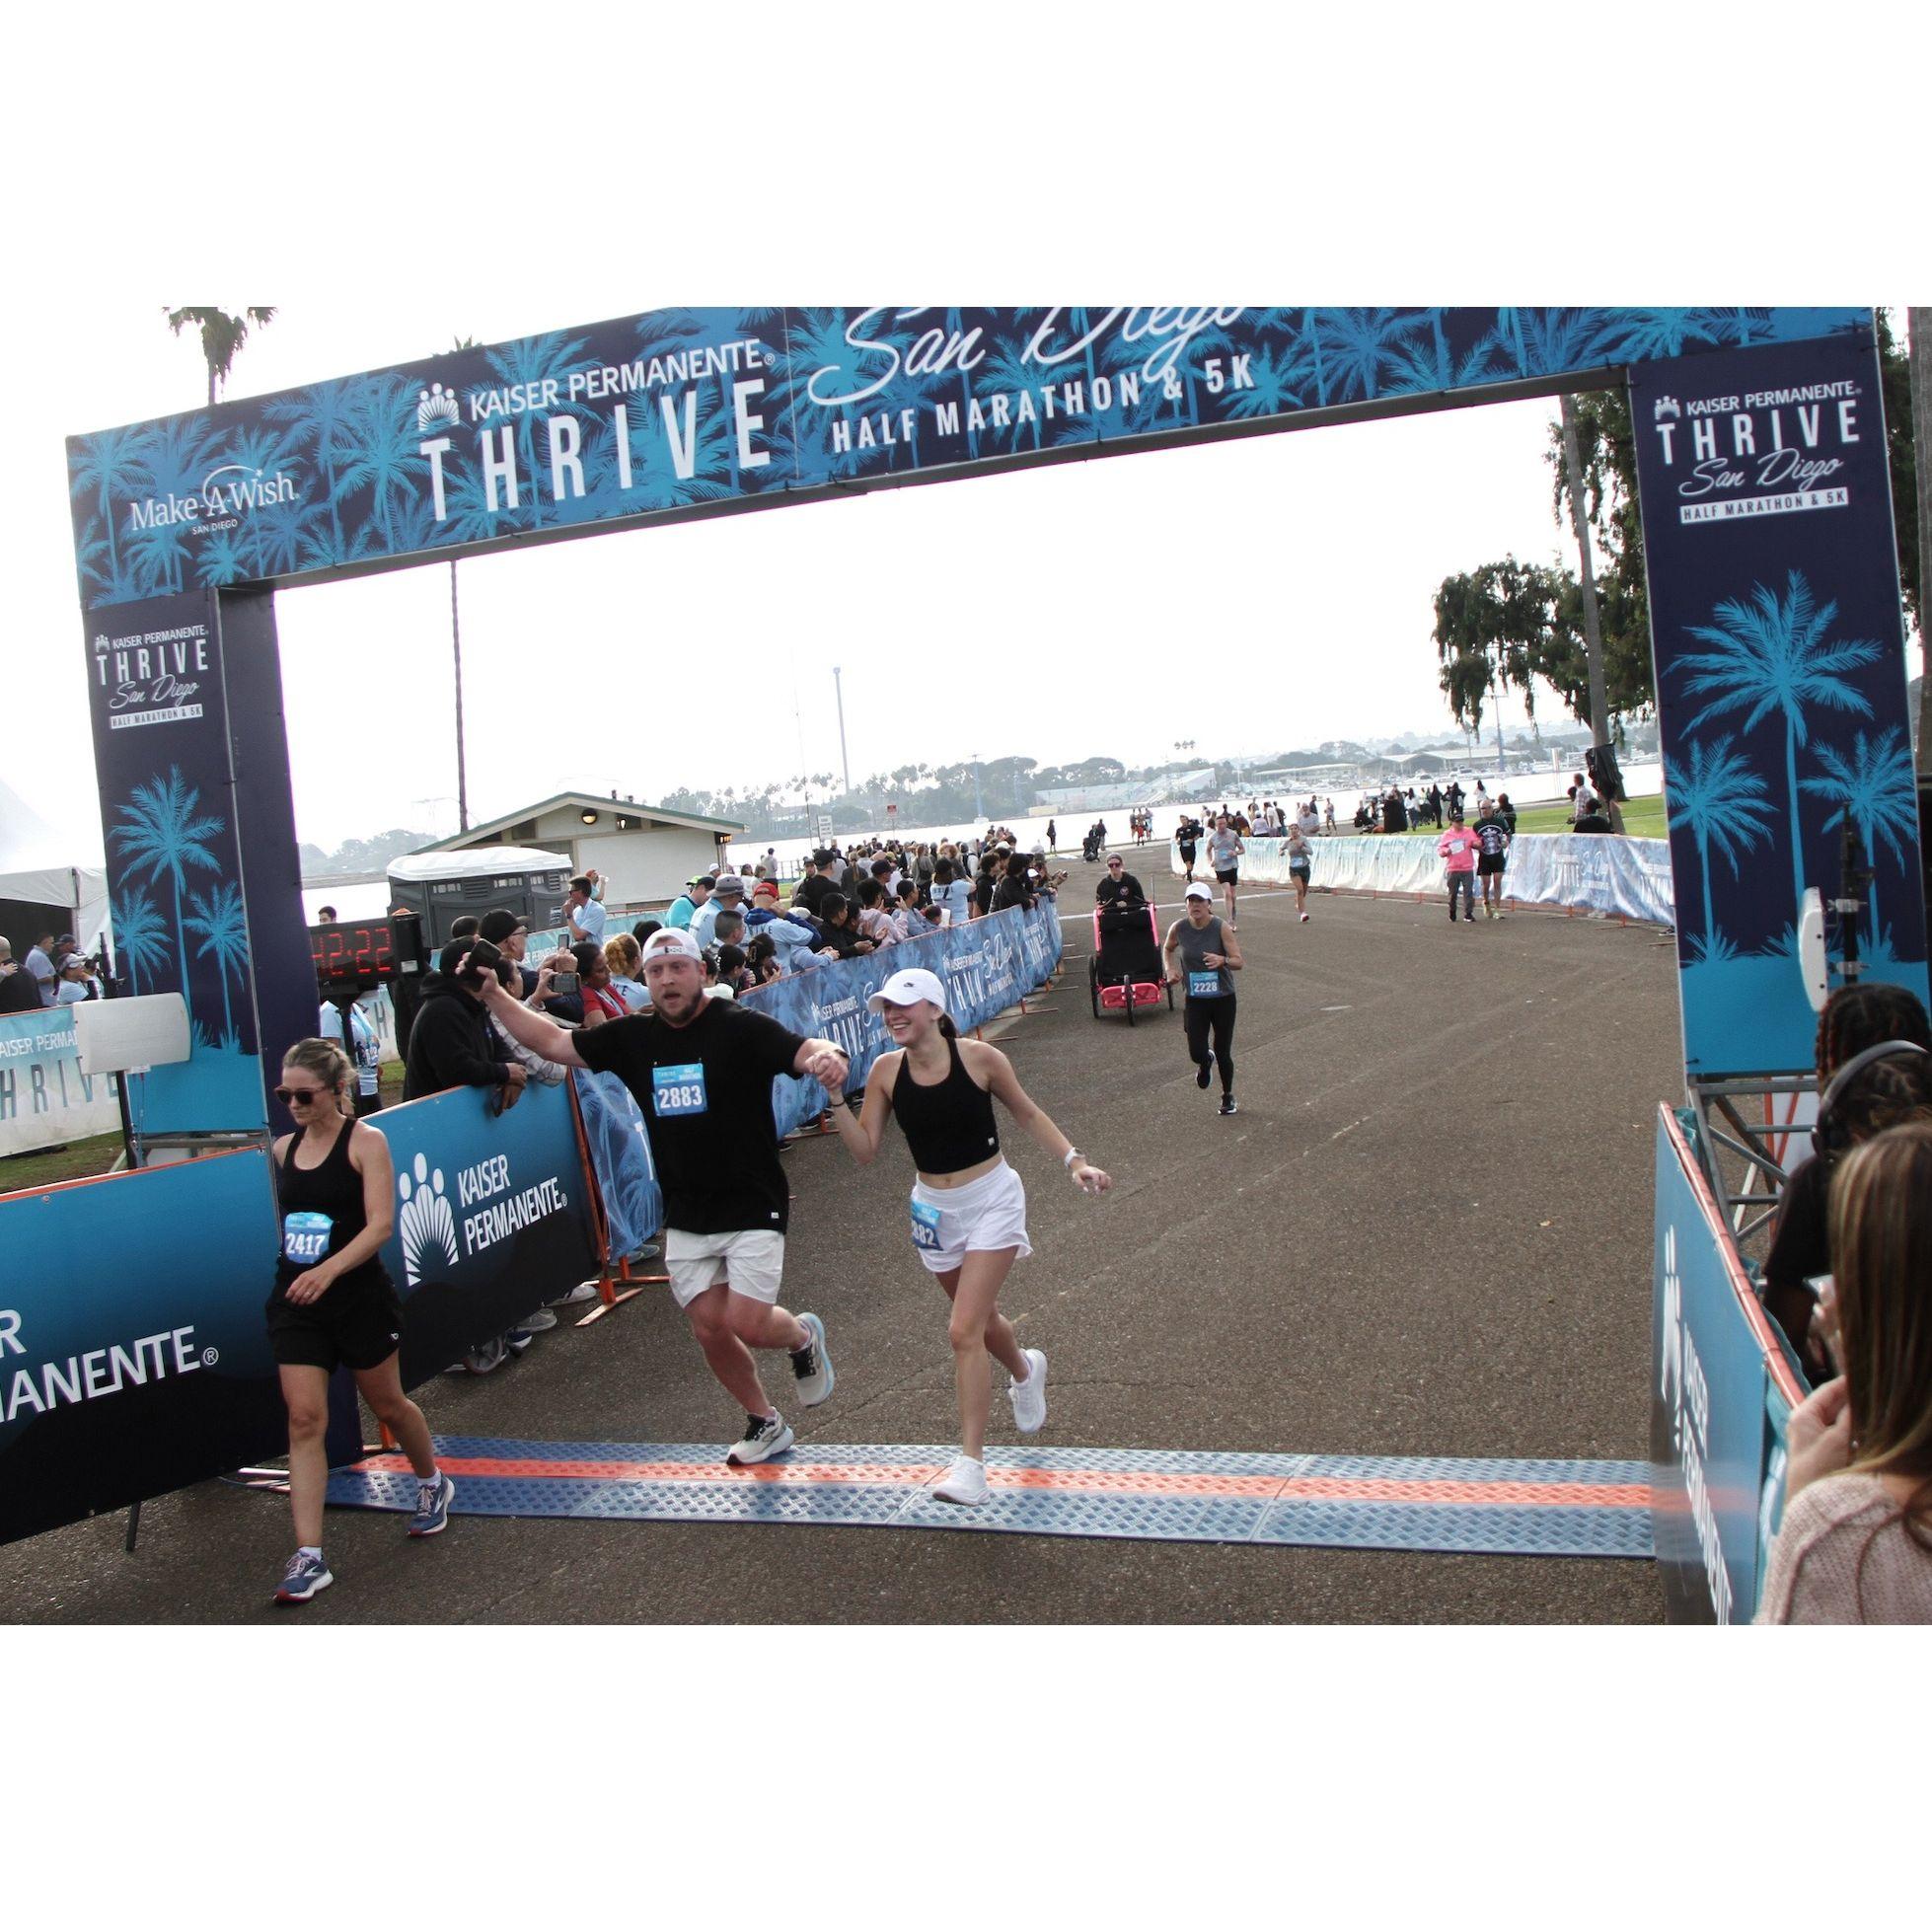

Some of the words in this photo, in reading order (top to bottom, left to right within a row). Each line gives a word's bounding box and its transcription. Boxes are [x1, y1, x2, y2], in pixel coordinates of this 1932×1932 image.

[807, 307, 986, 406] San
[471, 378, 559, 421] KAISER
[832, 408, 917, 453] HALF
[935, 371, 1141, 437] MARATHON
[1162, 364, 1184, 401] &
[1205, 353, 1255, 394] 5K
[1686, 396, 1740, 415] KAISER
[1656, 400, 1860, 465] THRIVE
[420, 379, 771, 522] THRIVE
[1678, 458, 1746, 496] San
[1755, 448, 1844, 492] Diego
[1683, 504, 1718, 521] HALF
[1725, 495, 1804, 516] MARATHON
[1812, 493, 1819, 505] &
[1826, 490, 1845, 504] 5K
[192, 524, 210, 535] SAN
[212, 518, 239, 532] DIEGO
[112, 635, 142, 649] KAISER
[97, 638, 208, 686] THRIVE
[110, 680, 146, 708] San
[152, 674, 199, 707] Diego
[111, 716, 130, 727] HALF
[134, 708, 179, 724] MARATHON
[1194, 982, 1218, 993] 2228
[658, 1084, 703, 1108] 2883
[458, 1154, 511, 1208] KAISER
[286, 1232, 326, 1255] 2417
[911, 1219, 936, 1246] 882
